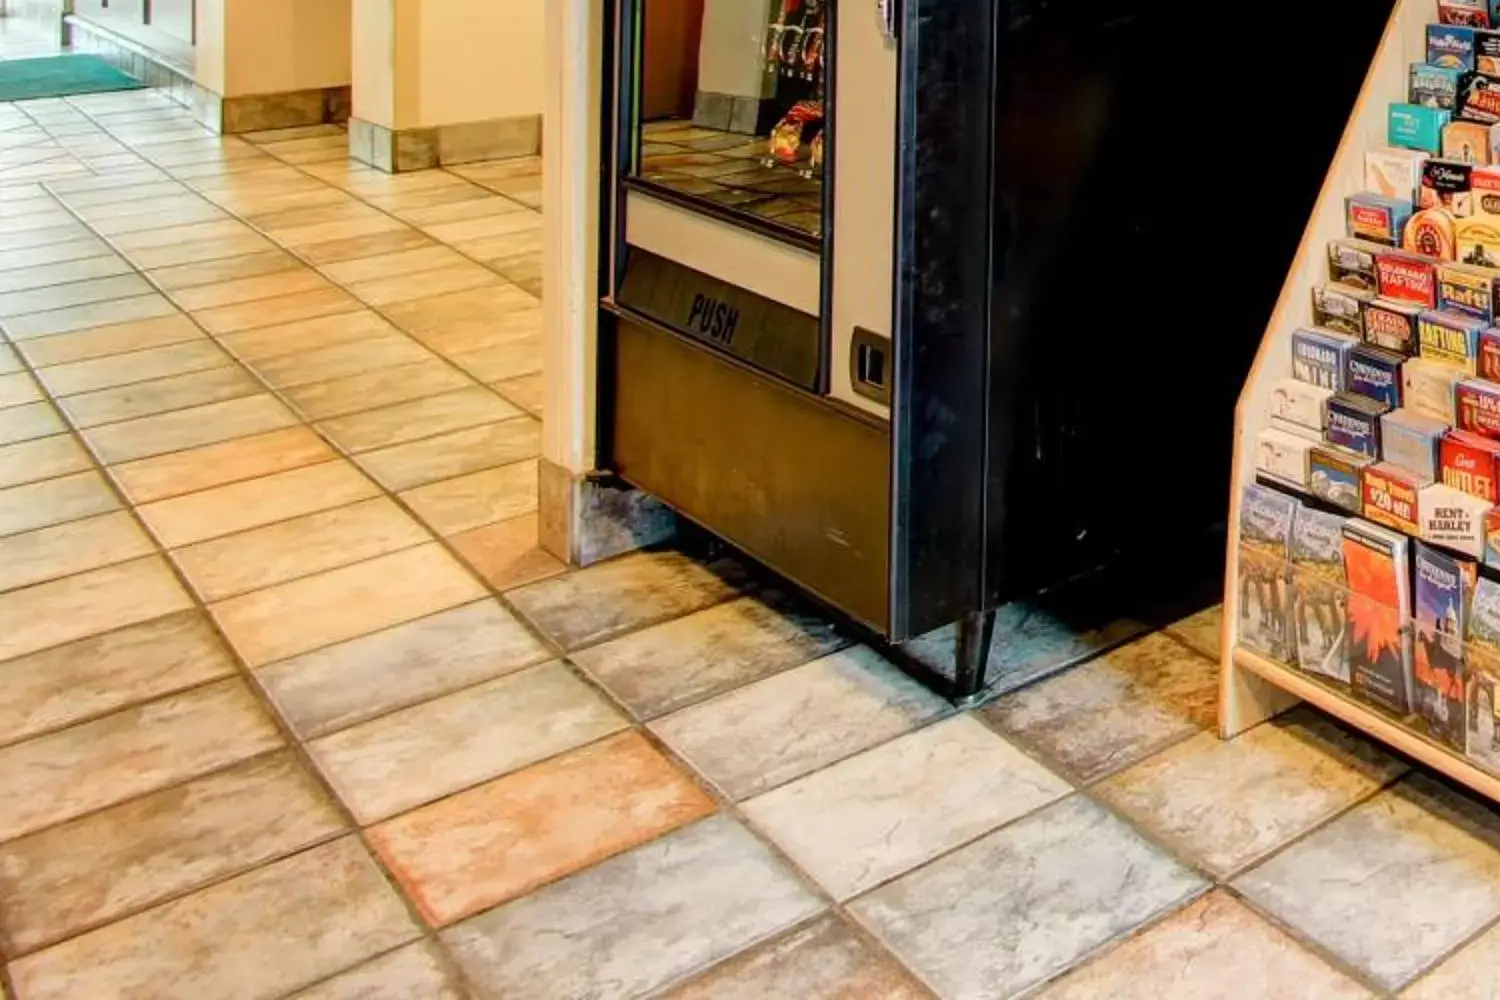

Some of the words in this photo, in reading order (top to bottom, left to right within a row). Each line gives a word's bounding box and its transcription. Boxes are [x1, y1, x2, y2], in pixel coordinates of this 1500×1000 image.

[1381, 271, 1433, 294] RAFTING
[687, 293, 741, 345] PUSH
[1443, 465, 1492, 499] OUTLET
[1428, 517, 1472, 532] HARLEY
[1434, 507, 1464, 520] RENT
